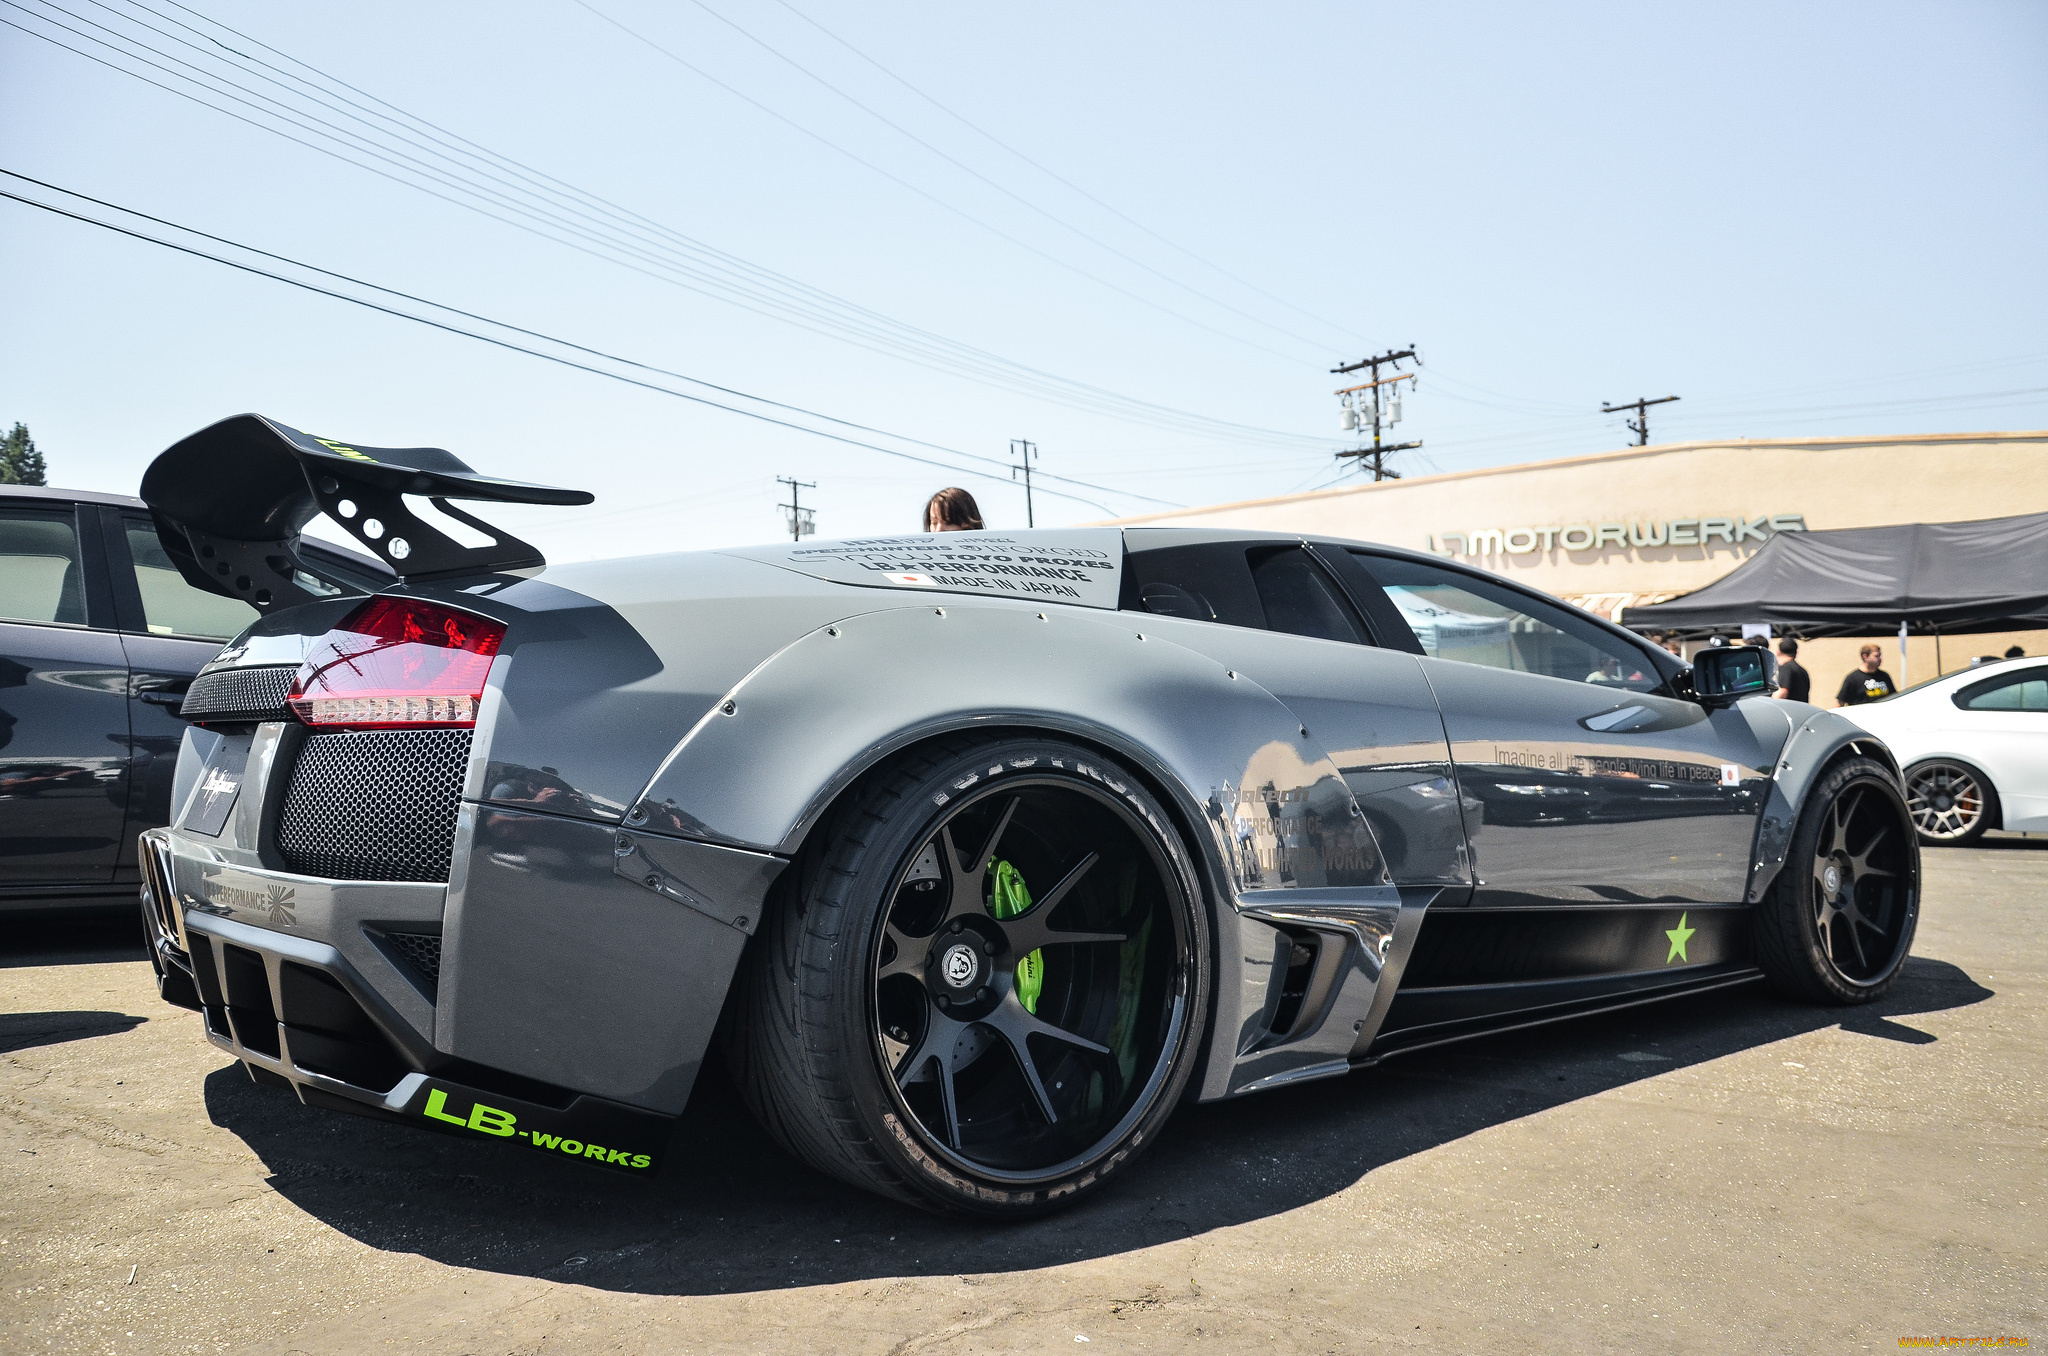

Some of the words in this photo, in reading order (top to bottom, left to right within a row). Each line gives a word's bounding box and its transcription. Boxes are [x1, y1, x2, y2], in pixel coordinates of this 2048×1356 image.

[858, 562, 897, 571] LB
[917, 562, 1093, 583] PERFORMANCE
[940, 554, 1013, 562] TOYO
[1018, 556, 1115, 570] PROXES
[930, 575, 995, 588] MADE
[992, 578, 1018, 591] IN
[1020, 580, 1081, 598] JAPAN
[1494, 745, 1545, 770] Imagine
[1549, 751, 1563, 770] all
[1567, 753, 1585, 771] the
[1589, 757, 1627, 777] people
[1628, 758, 1657, 778] living
[1659, 760, 1675, 778] life
[1677, 762, 1687, 778] in
[1689, 764, 1720, 783] peace
